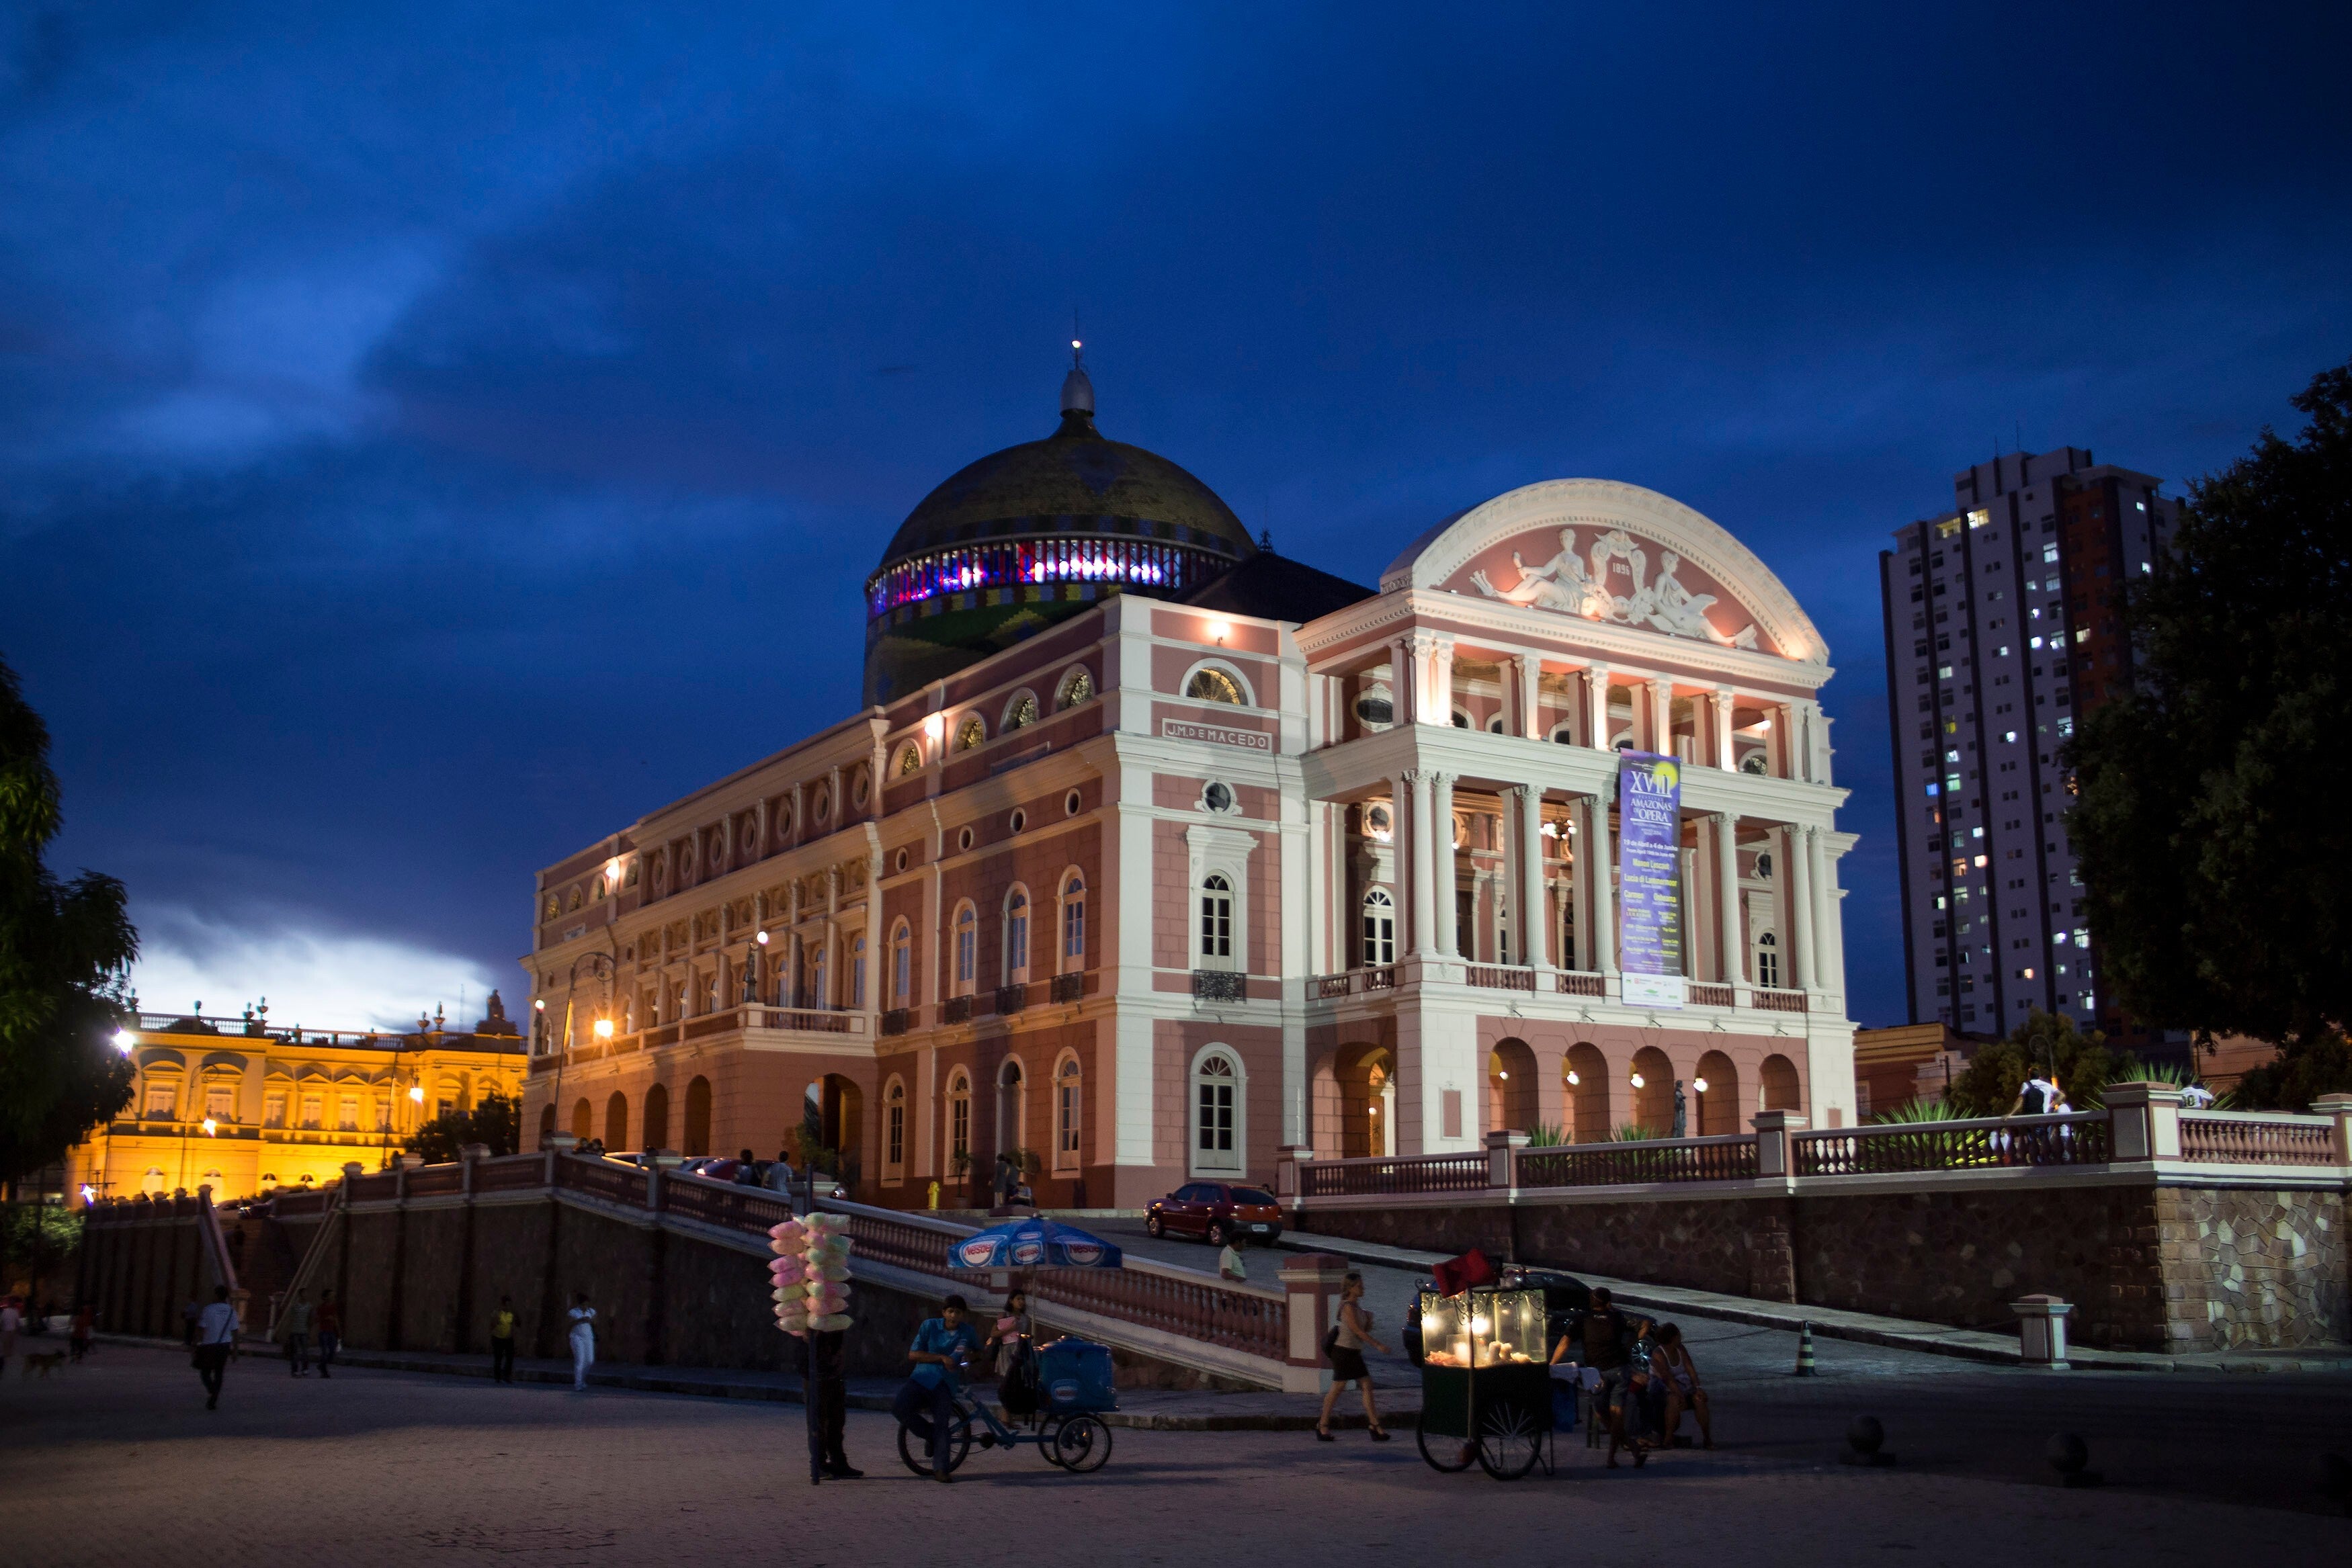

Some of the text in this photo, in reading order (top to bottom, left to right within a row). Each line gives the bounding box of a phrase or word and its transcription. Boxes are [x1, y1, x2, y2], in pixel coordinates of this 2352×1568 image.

[1613, 562, 1630, 576] 1896
[1208, 730, 1266, 747] MACEDO
[1630, 771, 1671, 796] XVIII
[1630, 798, 1672, 811] AMAZONAS
